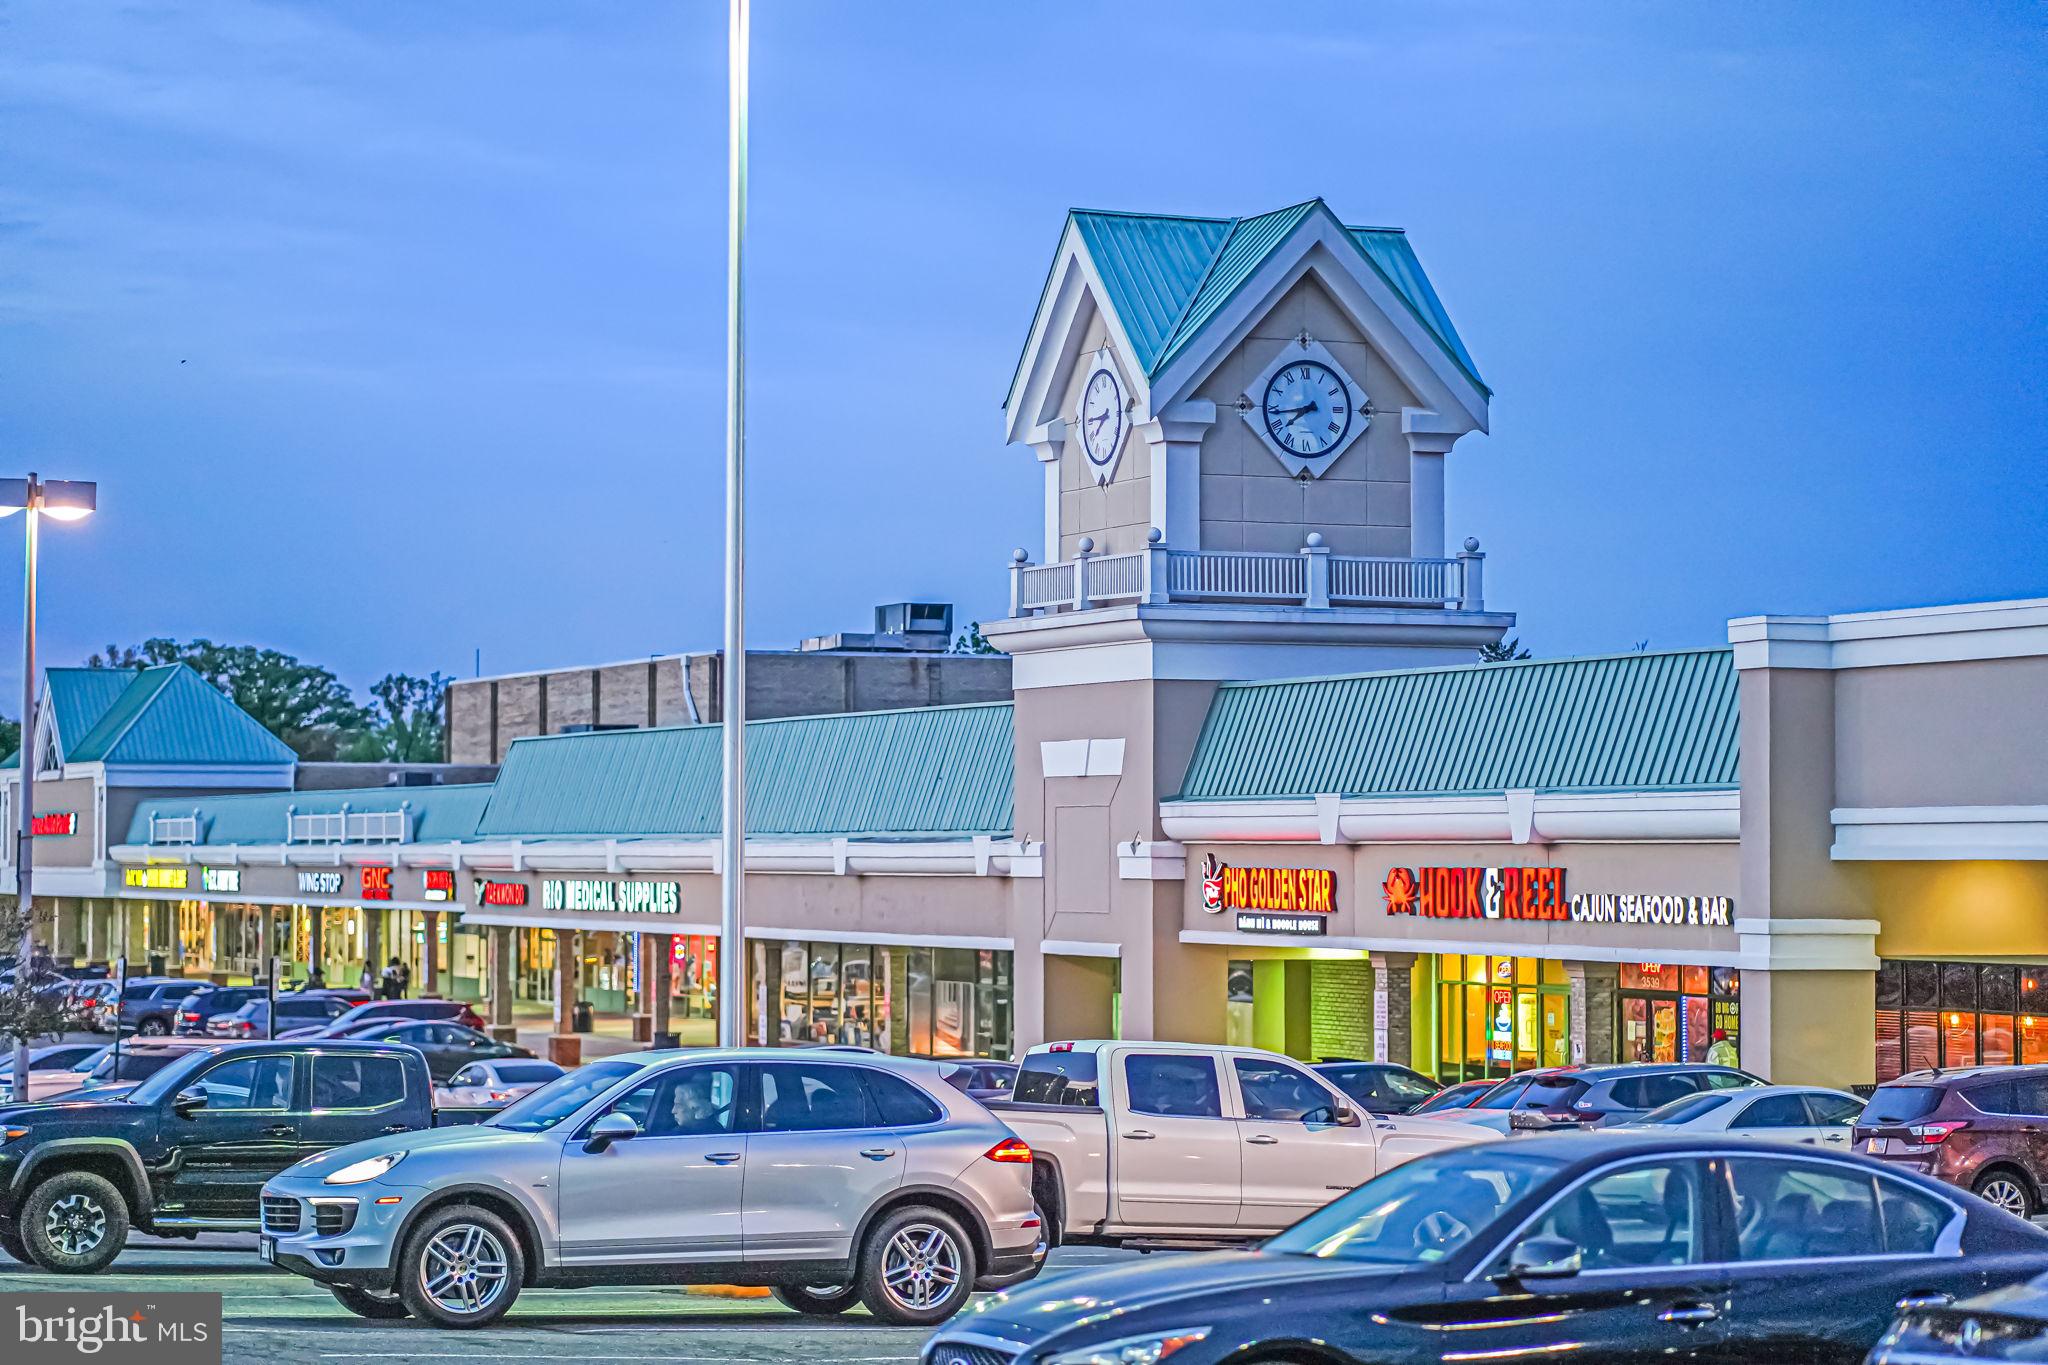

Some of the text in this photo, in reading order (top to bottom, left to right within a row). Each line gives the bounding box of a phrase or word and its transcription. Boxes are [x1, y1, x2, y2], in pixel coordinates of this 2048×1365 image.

[298, 872, 341, 893] WING STOP
[362, 867, 390, 889] GNC
[543, 879, 678, 913] RIO MEDICAL SUPPLIES
[1224, 867, 1332, 912] PHO GOLDEN STAR
[1419, 867, 1569, 920] HOOK & REEL
[1571, 894, 1730, 925] CAJUN SEAFOOD & BAR
[1641, 963, 1661, 973] OPEN
[1641, 977, 1660, 988] 3539
[1715, 1014, 1723, 1029] GO
